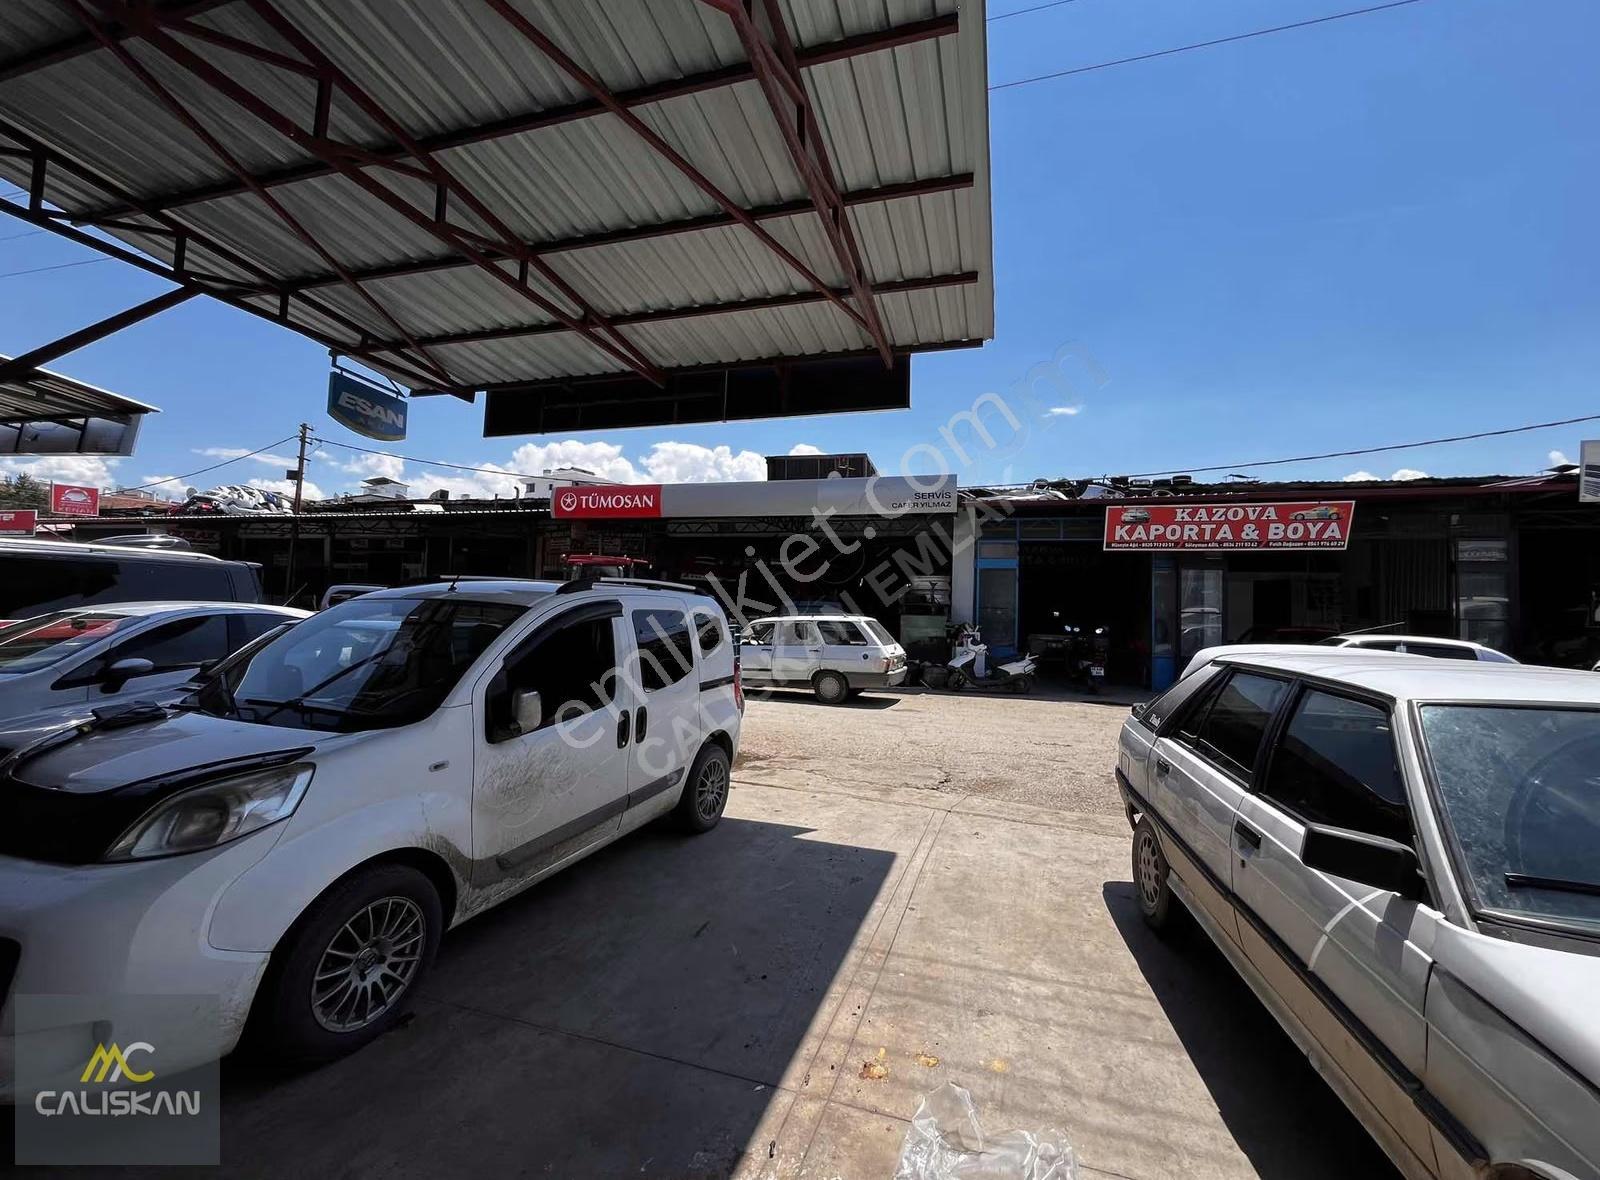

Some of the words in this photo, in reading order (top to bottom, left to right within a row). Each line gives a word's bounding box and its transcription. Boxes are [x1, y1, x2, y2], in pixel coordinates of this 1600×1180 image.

[338, 391, 404, 429] ESAN
[580, 493, 653, 508] TÜMOSAN
[1174, 506, 1278, 521] KAZOVA
[1114, 524, 1233, 541] KAPORTA
[1241, 523, 1260, 540] &
[1267, 522, 1342, 539] BOYA
